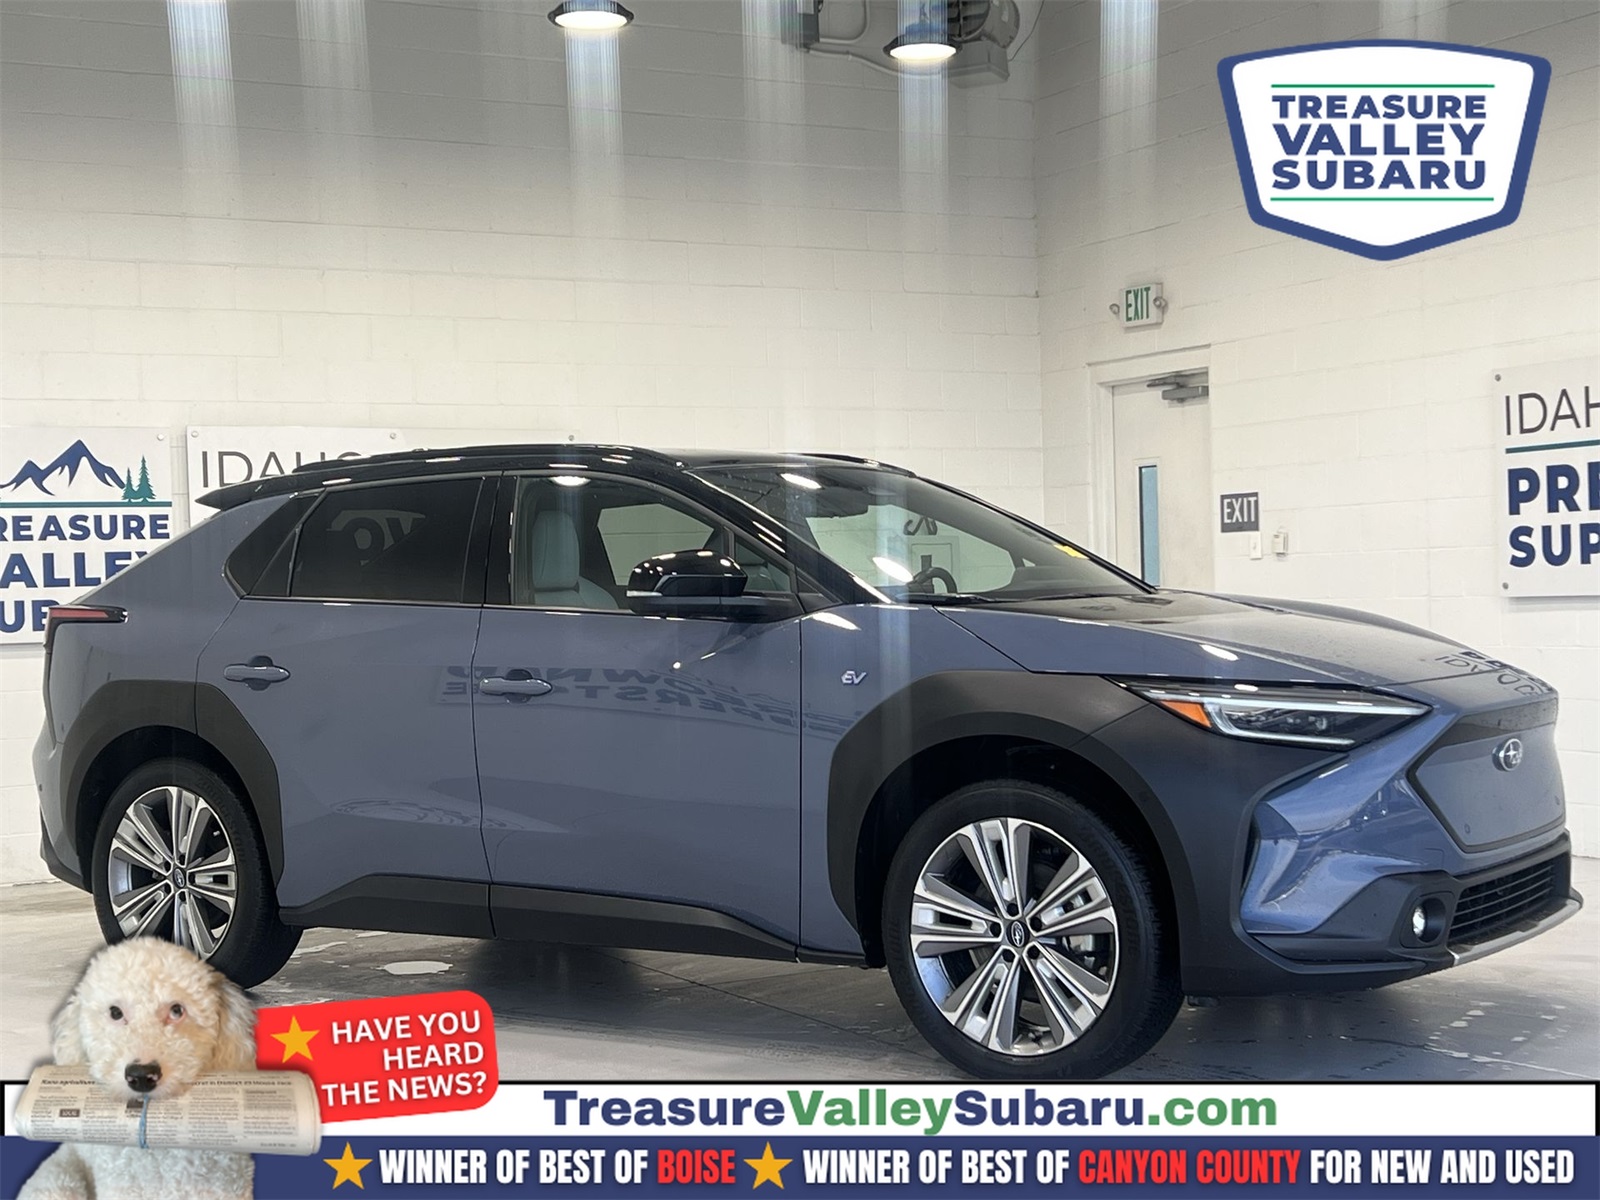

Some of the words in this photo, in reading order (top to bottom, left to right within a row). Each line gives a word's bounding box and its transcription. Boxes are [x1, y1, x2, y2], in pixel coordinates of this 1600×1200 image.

[1125, 286, 1151, 322] EXIT
[202, 450, 362, 488] IDA
[1223, 496, 1258, 524] EXIT
[0, 551, 149, 589] ALLE
[841, 670, 867, 684] EV
